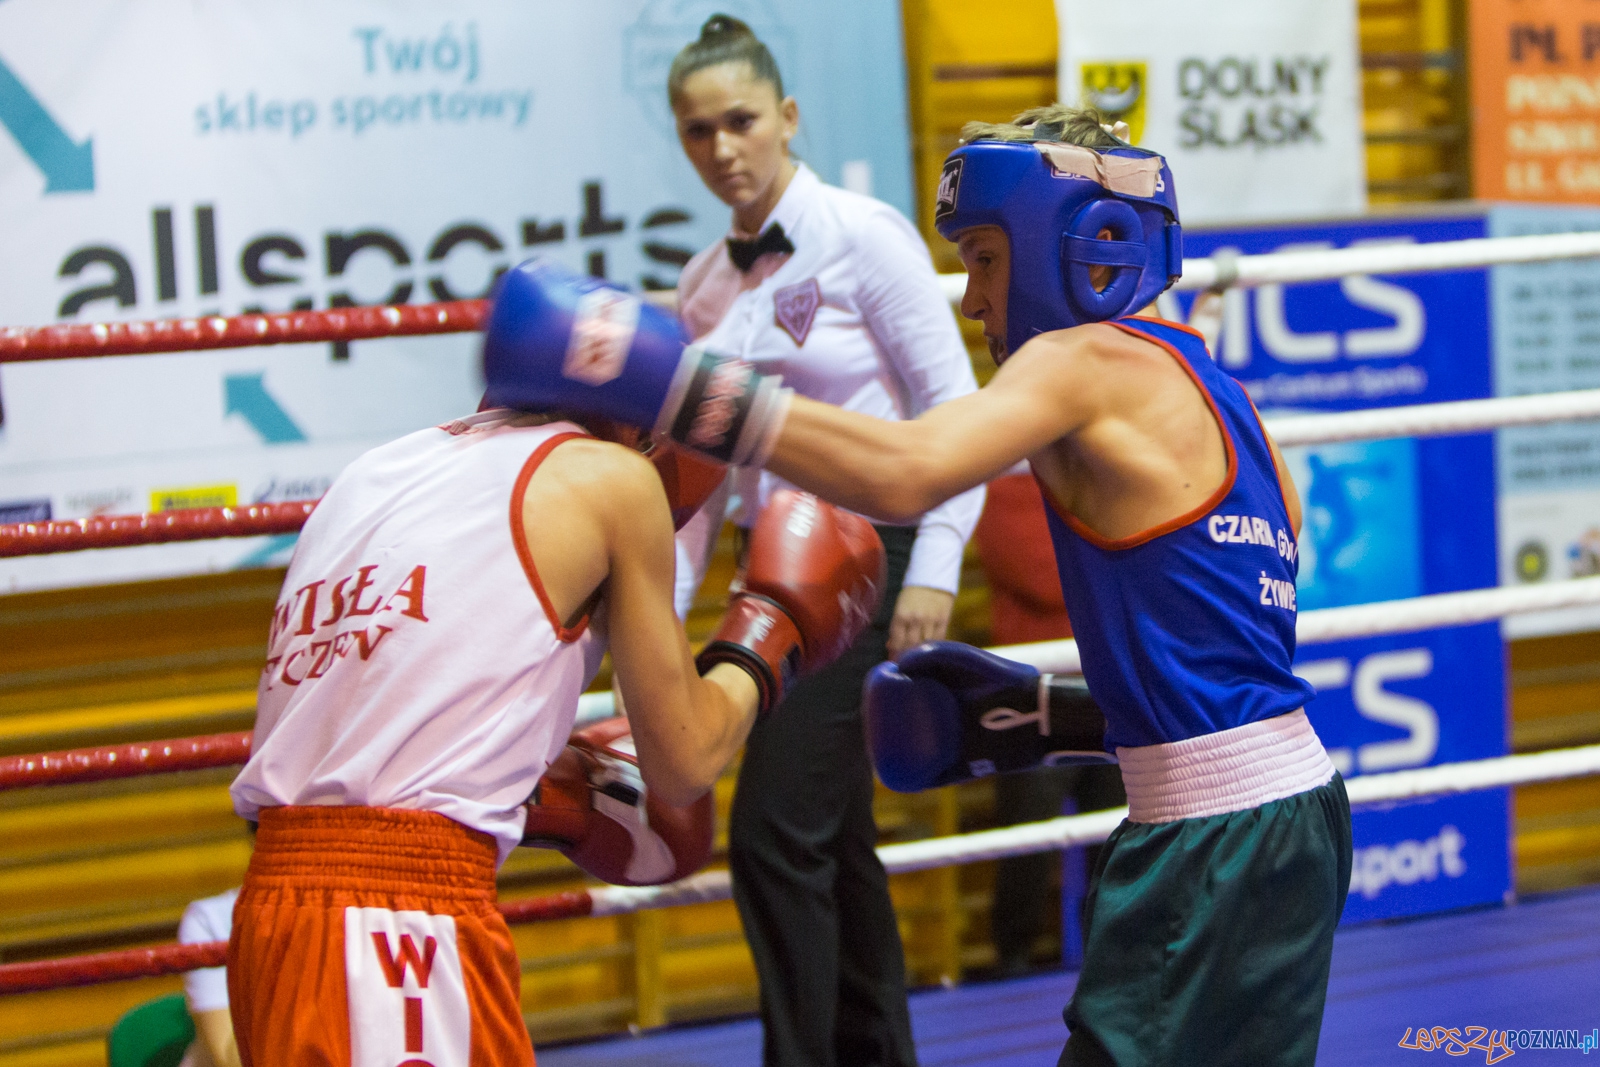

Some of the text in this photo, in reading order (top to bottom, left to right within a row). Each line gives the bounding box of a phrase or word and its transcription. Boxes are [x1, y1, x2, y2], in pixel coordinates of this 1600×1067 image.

[353, 22, 481, 81] Twój
[1177, 57, 1330, 100] DOLNY
[195, 88, 534, 137] sklep sportowy
